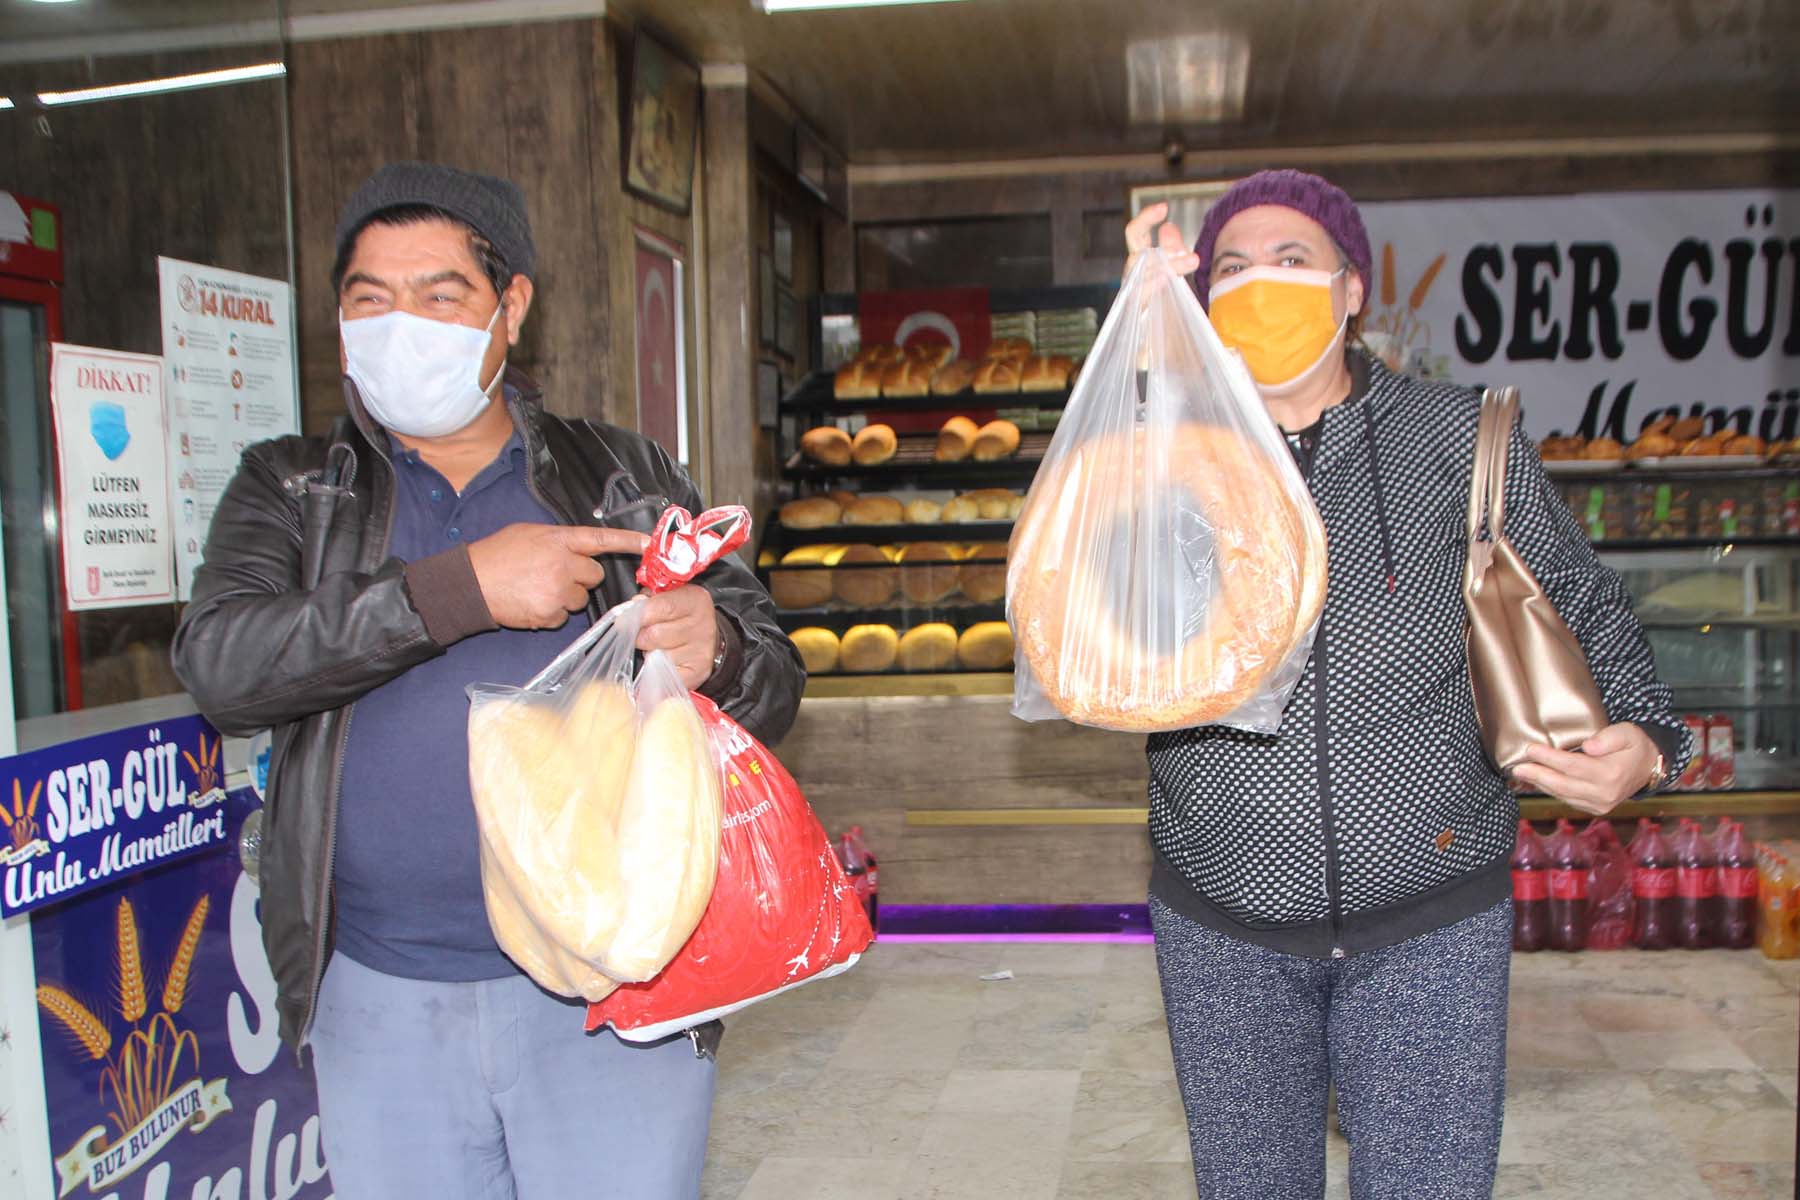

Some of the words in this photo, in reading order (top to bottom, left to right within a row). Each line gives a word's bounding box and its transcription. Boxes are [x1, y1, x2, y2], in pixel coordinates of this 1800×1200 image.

[199, 289, 218, 316] 14
[221, 293, 274, 326] KURAL
[77, 362, 152, 394] DİKKAT!
[92, 473, 140, 492] LÜTFEN
[87, 499, 150, 518] MASKESİZ
[83, 525, 157, 545] GİRMEYİNİZ
[46, 727, 187, 844] SER-GÜL
[4, 851, 87, 909] Unlu
[88, 808, 227, 880] Mamülleri
[92, 1145, 126, 1185] BUZ
[129, 1087, 202, 1159] BULUNUR
